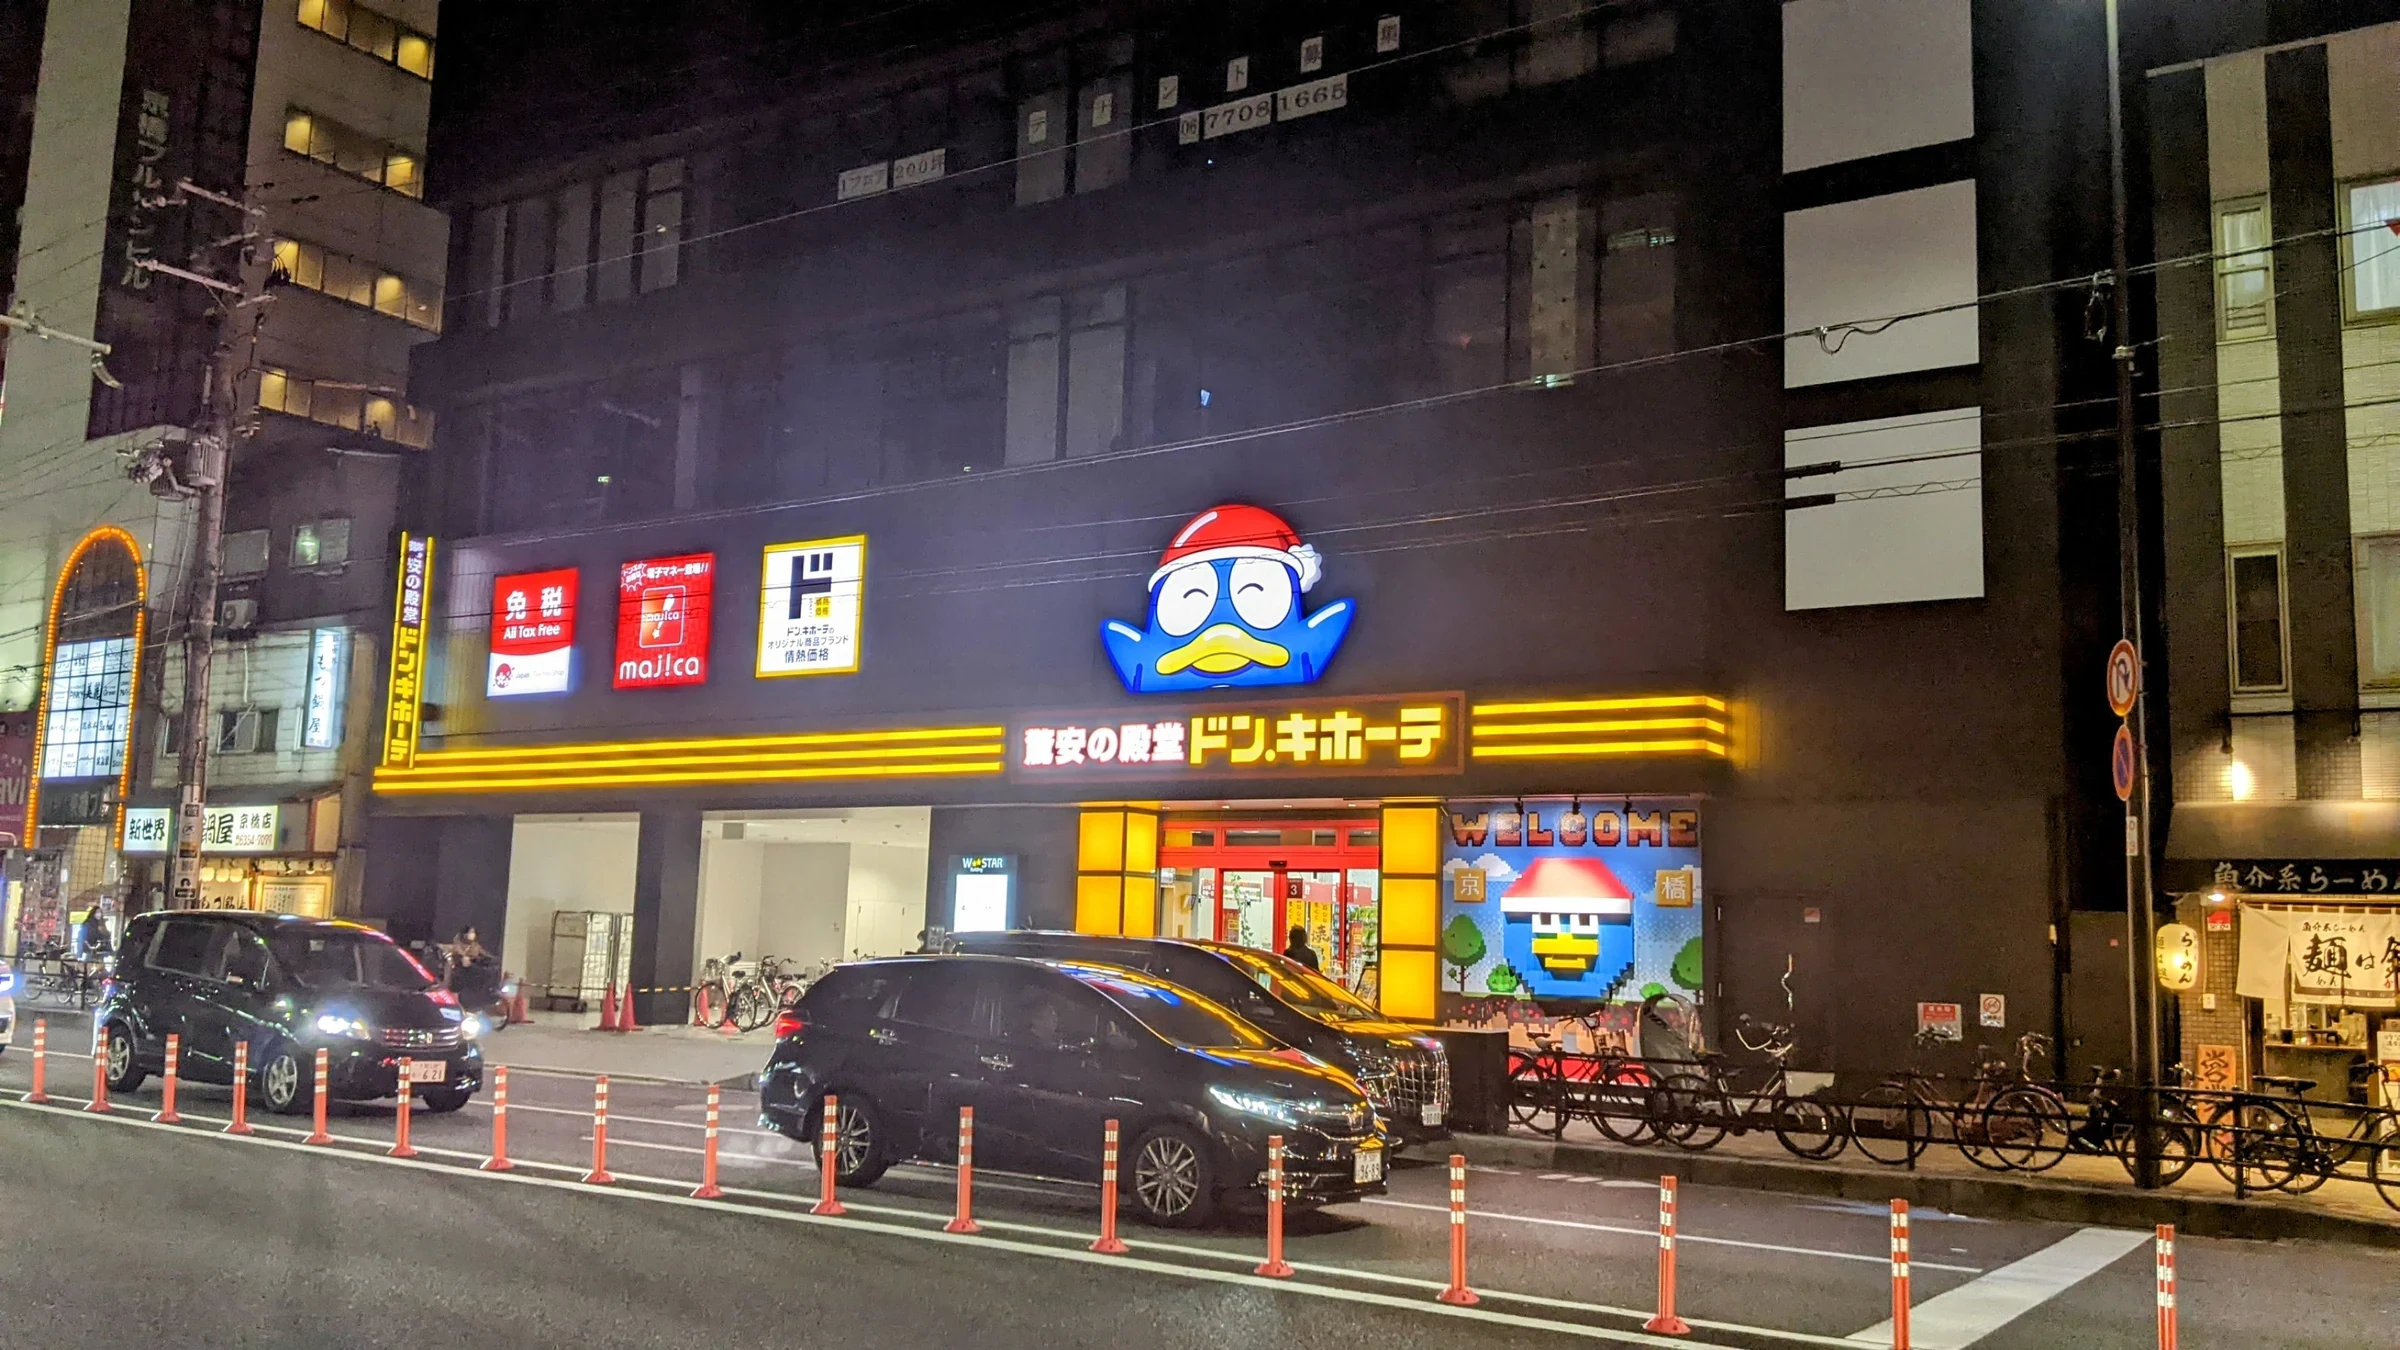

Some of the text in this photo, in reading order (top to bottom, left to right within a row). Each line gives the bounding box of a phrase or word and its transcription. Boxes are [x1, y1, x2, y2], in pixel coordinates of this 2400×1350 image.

[1206, 101, 1271, 129] 7708
[1279, 82, 1346, 111] 1665
[504, 585, 563, 621] 免税
[518, 625, 536, 638] Tax
[538, 623, 561, 637] Free
[129, 817, 165, 841] 新世界
[1451, 810, 1699, 847] WELCOME
[1460, 872, 1687, 900] 京 橋
[2214, 860, 2400, 893] 魚介系らーめ
